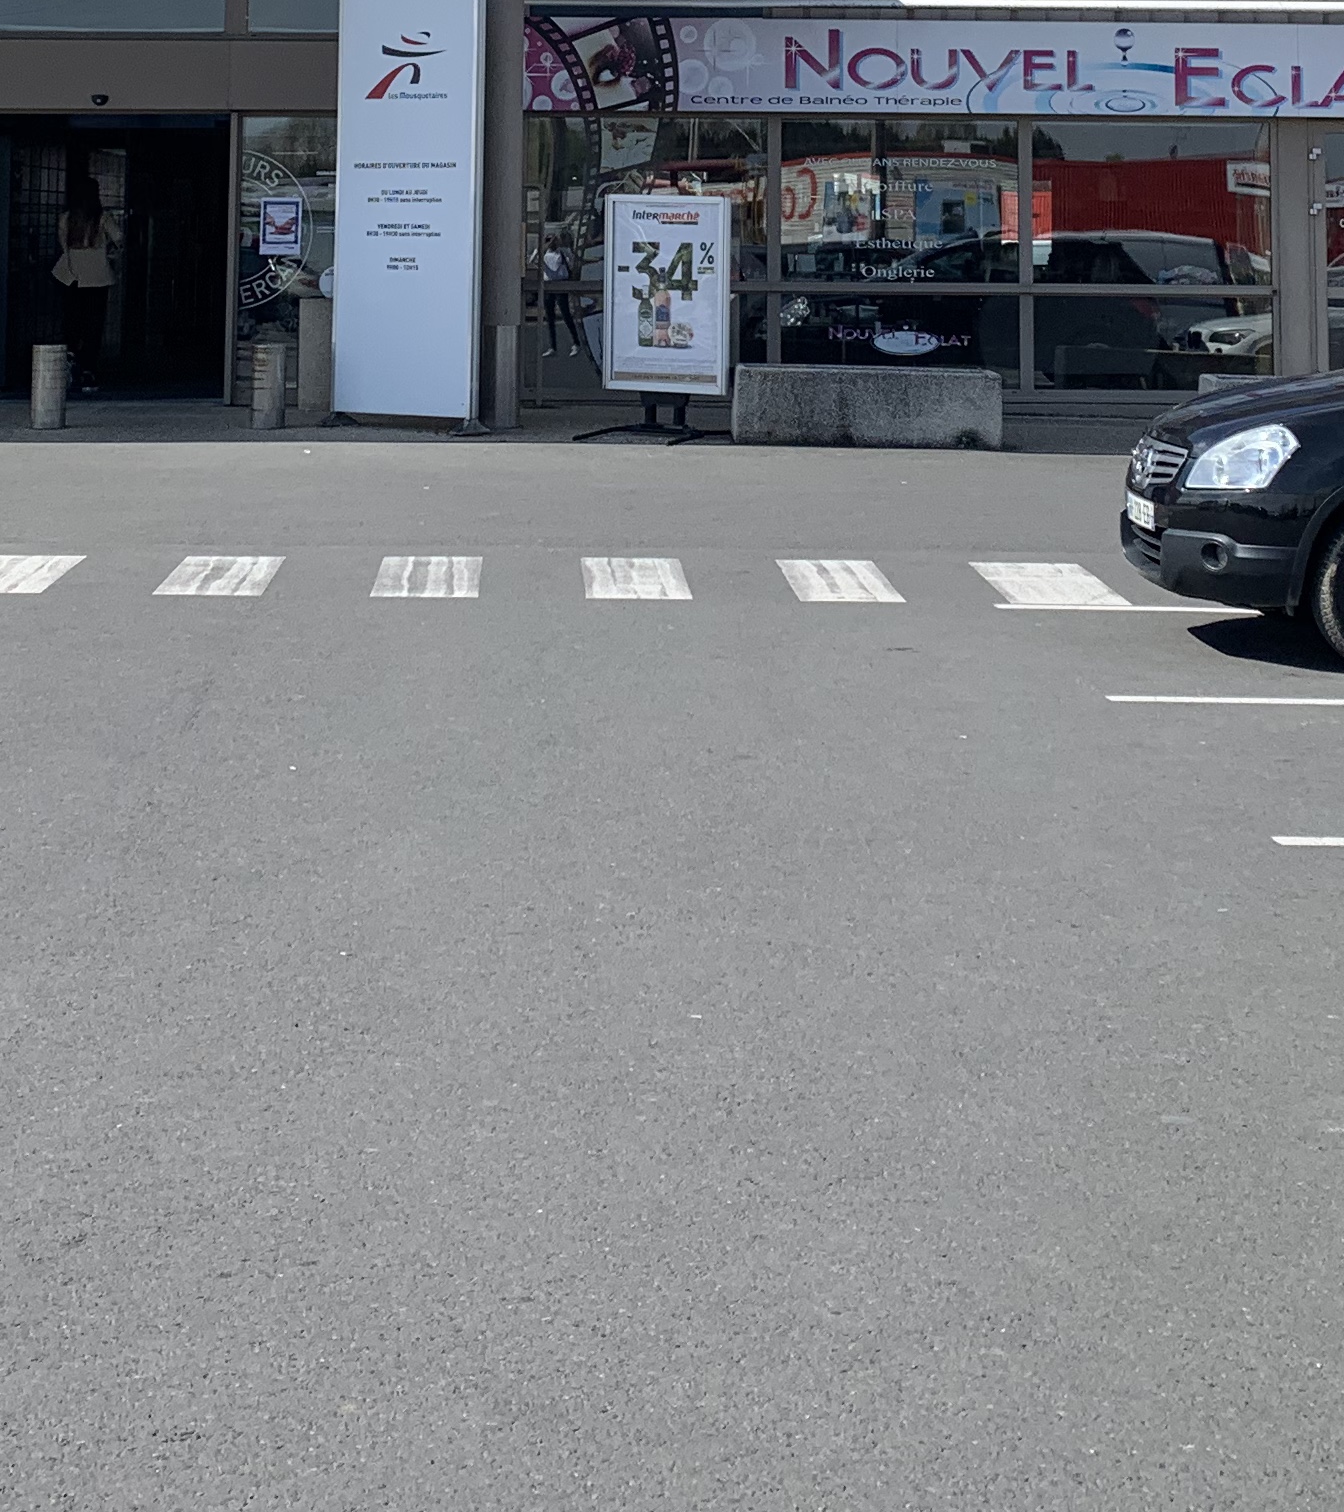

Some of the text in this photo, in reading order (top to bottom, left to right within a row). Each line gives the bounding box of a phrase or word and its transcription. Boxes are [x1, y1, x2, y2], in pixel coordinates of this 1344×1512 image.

[690, 94, 962, 108] Centre de Balnéo Thérapie
[866, 158, 900, 167] ANS
[903, 158, 997, 168] RENDEZ-VOUS
[868, 180, 933, 192] oiffure
[861, 265, 935, 280] Onglerie
